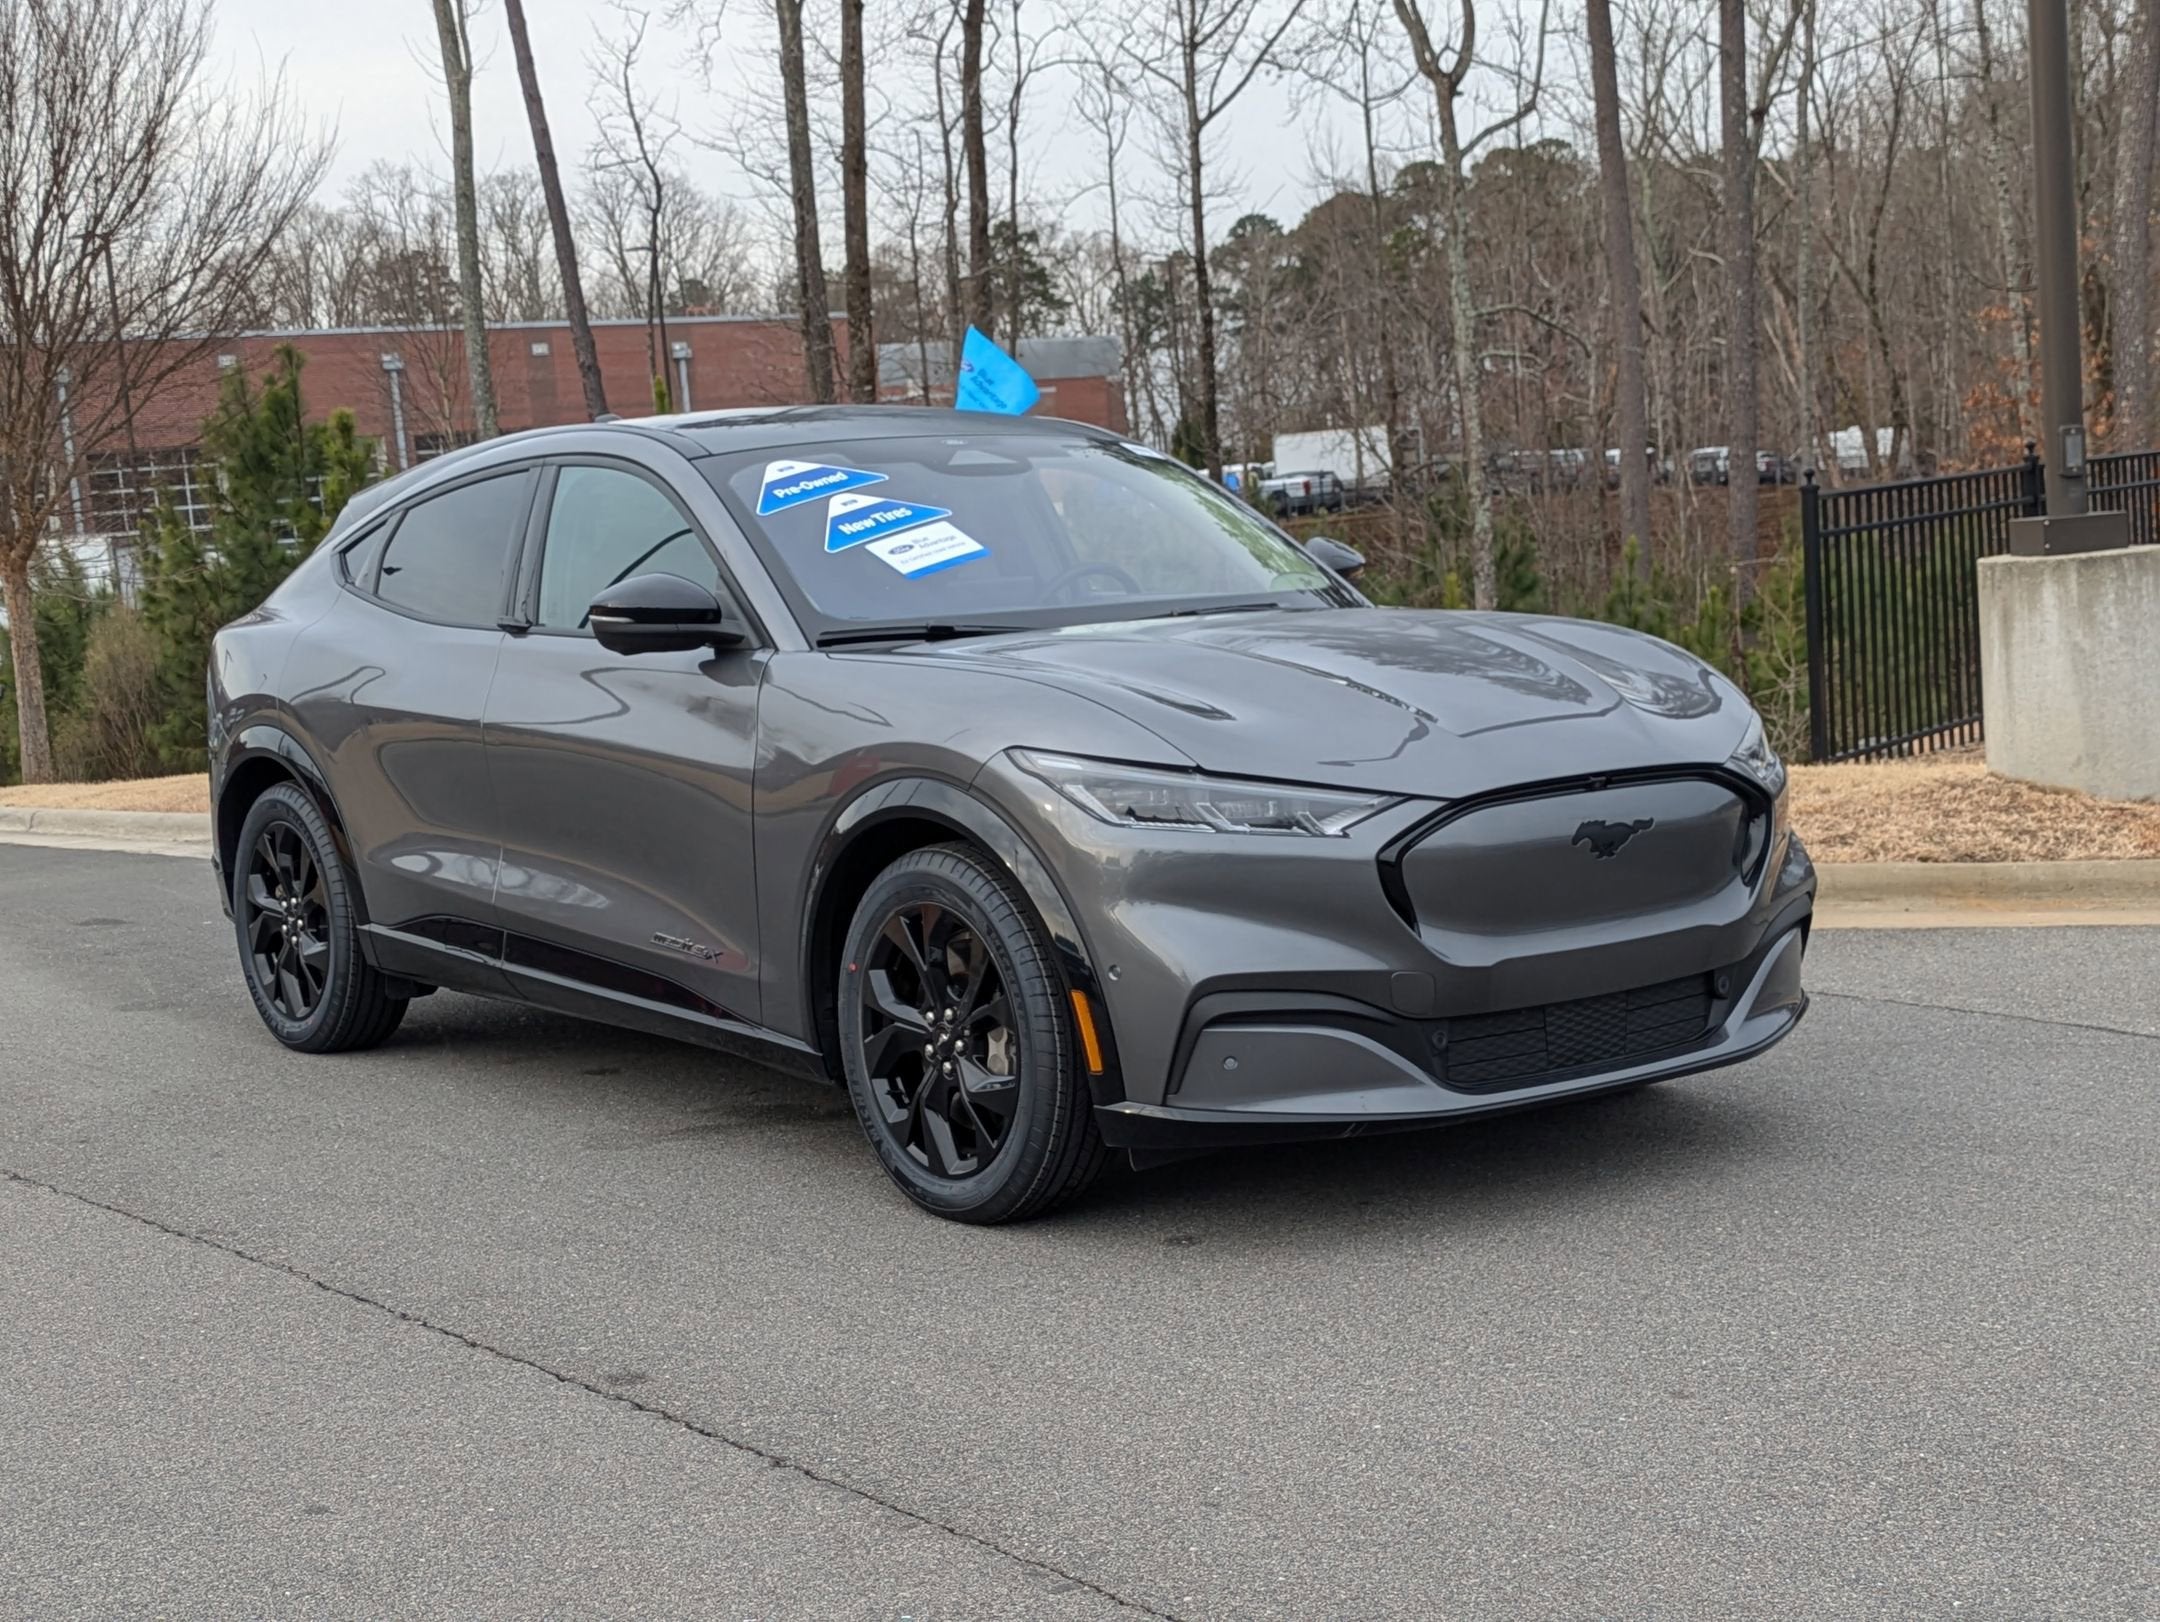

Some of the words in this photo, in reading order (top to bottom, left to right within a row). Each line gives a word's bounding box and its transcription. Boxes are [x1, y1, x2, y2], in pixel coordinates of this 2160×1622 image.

[772, 471, 849, 499] Pre-Owned
[837, 518, 877, 535] New
[870, 507, 913, 524] Tires
